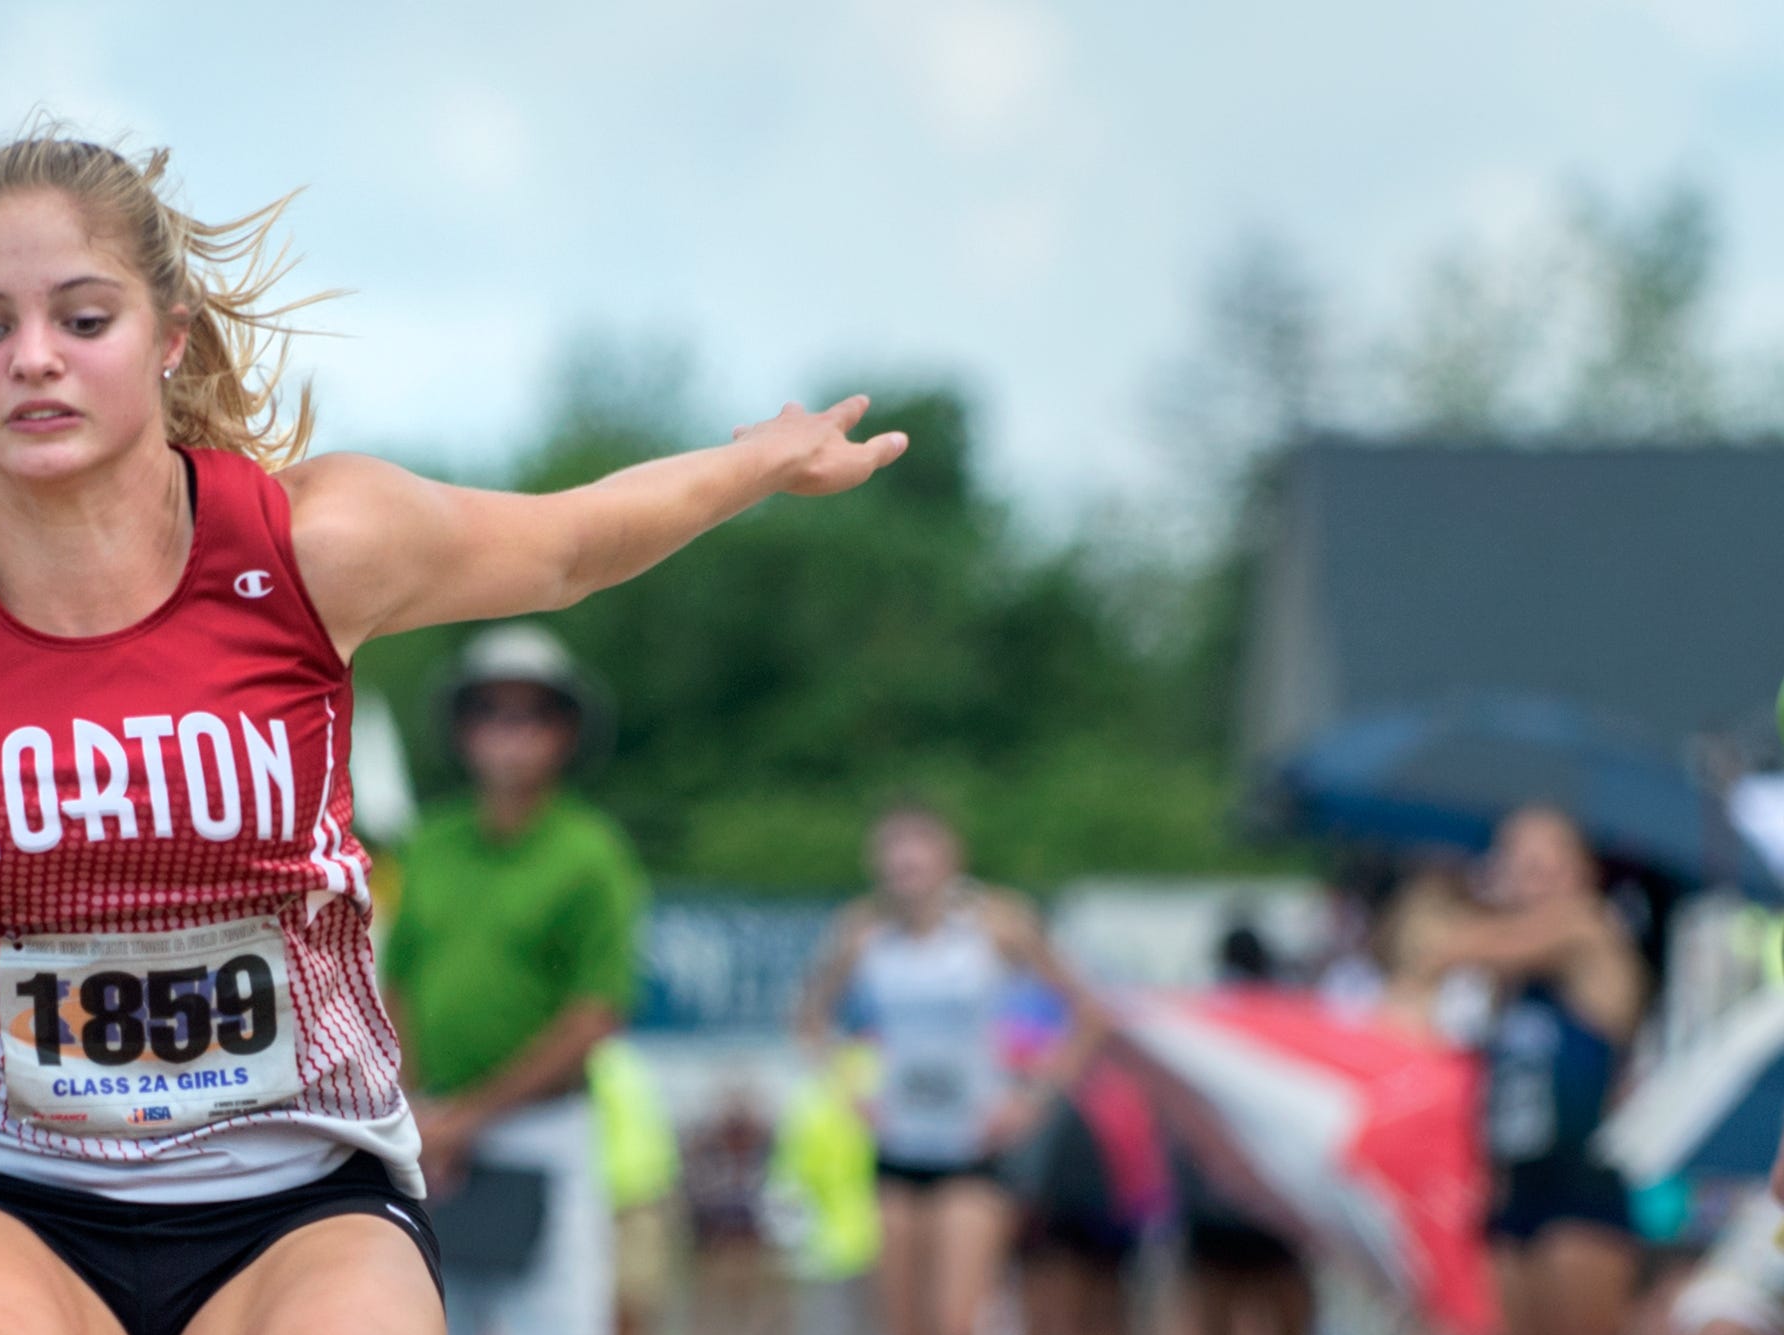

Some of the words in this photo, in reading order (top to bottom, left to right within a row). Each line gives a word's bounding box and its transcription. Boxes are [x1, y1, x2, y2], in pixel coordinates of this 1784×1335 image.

[17, 954, 277, 1066] 1859
[53, 1075, 130, 1097] CLASS
[138, 1075, 169, 1093] 2A
[177, 1067, 249, 1090] GIRLS
